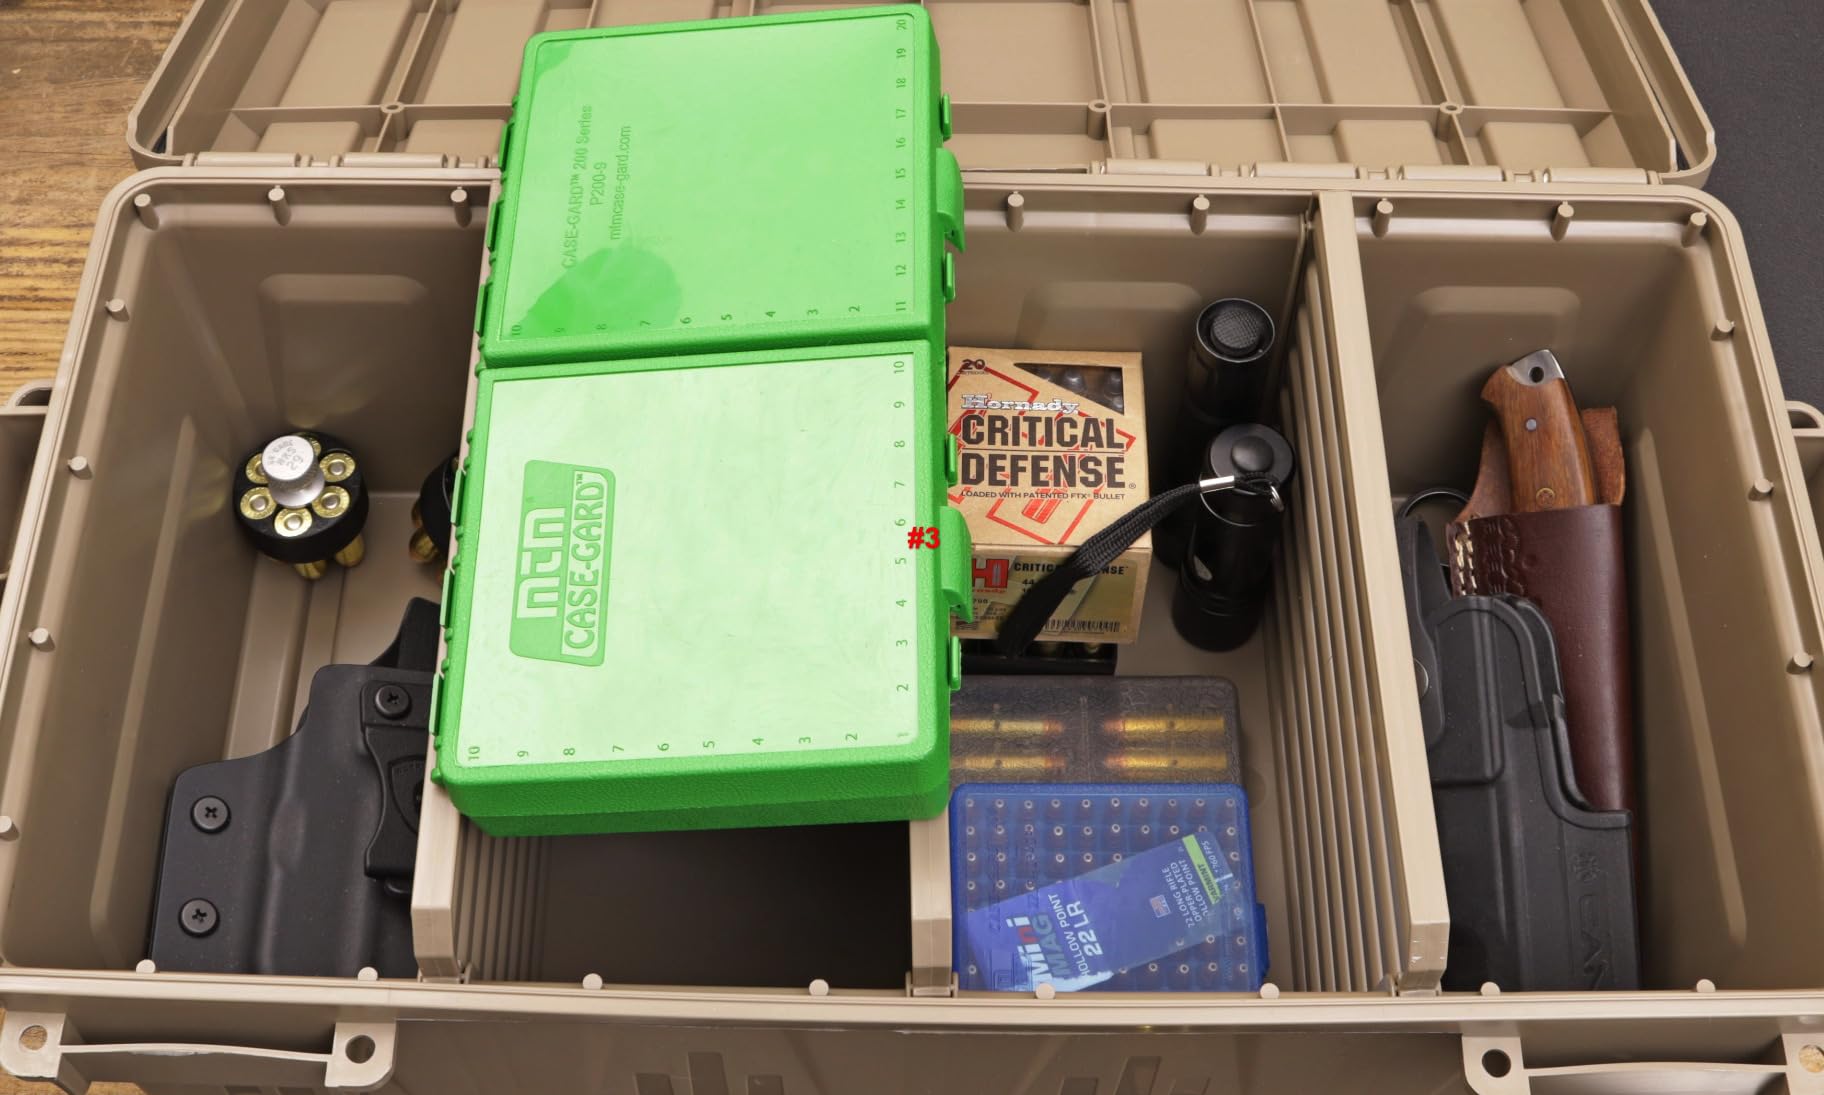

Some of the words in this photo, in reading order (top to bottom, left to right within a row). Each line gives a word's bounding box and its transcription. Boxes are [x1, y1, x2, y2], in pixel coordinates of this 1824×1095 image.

[895, 19, 907, 31] 20
[895, 47, 907, 59] 19
[895, 77, 907, 89] 18
[895, 108, 907, 120] 17
[575, 104, 592, 144] Series
[895, 137, 907, 149] 16
[573, 147, 588, 170] 200
[895, 167, 907, 180] 15
[589, 161, 607, 206] P200-9
[609, 125, 631, 240] mtmcase-gard.com
[895, 198, 907, 210] 14
[895, 231, 907, 244] 13
[895, 264, 907, 277] 12
[806, 308, 819, 316] 3
[848, 305, 861, 313] 2
[895, 300, 907, 312] 11
[720, 313, 733, 321] 5
[764, 310, 777, 318] 4
[679, 316, 693, 325] 6
[511, 324, 522, 336] 10
[892, 360, 905, 375] 10
[962, 358, 986, 371] 20
[892, 400, 905, 409] 9
[961, 393, 1079, 415] Hornady
[961, 414, 1125, 450] CRITICAL
[893, 439, 905, 449] 8
[286, 454, 304, 471] 29
[893, 480, 905, 489] 7
[961, 490, 997, 499] LOADED
[999, 491, 1023, 499] WITH
[1023, 491, 1069, 500] PATENTED
[1093, 492, 1126, 501] BULLET
[893, 517, 906, 527] 6
[894, 557, 907, 566] 5
[895, 598, 908, 608] 4
[895, 639, 908, 648] 3
[896, 683, 909, 693] 2
[751, 736, 765, 746] 4
[797, 736, 812, 745] 3
[844, 732, 859, 742] 2
[611, 744, 625, 753] 7
[656, 742, 671, 752] 6
[702, 740, 716, 749] 5
[467, 745, 481, 760] 10
[516, 750, 530, 759] 9
[562, 747, 577, 757] 8
[1200, 840, 1214, 855] FPS
[1161, 866, 1178, 891] RIFLE
[1178, 859, 1196, 886] POINT
[1170, 862, 1203, 922] OPPER-PLATED
[1173, 891, 1190, 917] LONG
[1189, 887, 1209, 917] OLLOW
[1047, 893, 1071, 929] POINT
[1065, 900, 1091, 929] LR
[1031, 912, 1073, 978] MAG
[1077, 929, 1104, 957] 22
[1063, 931, 1091, 976] HOLLOW
